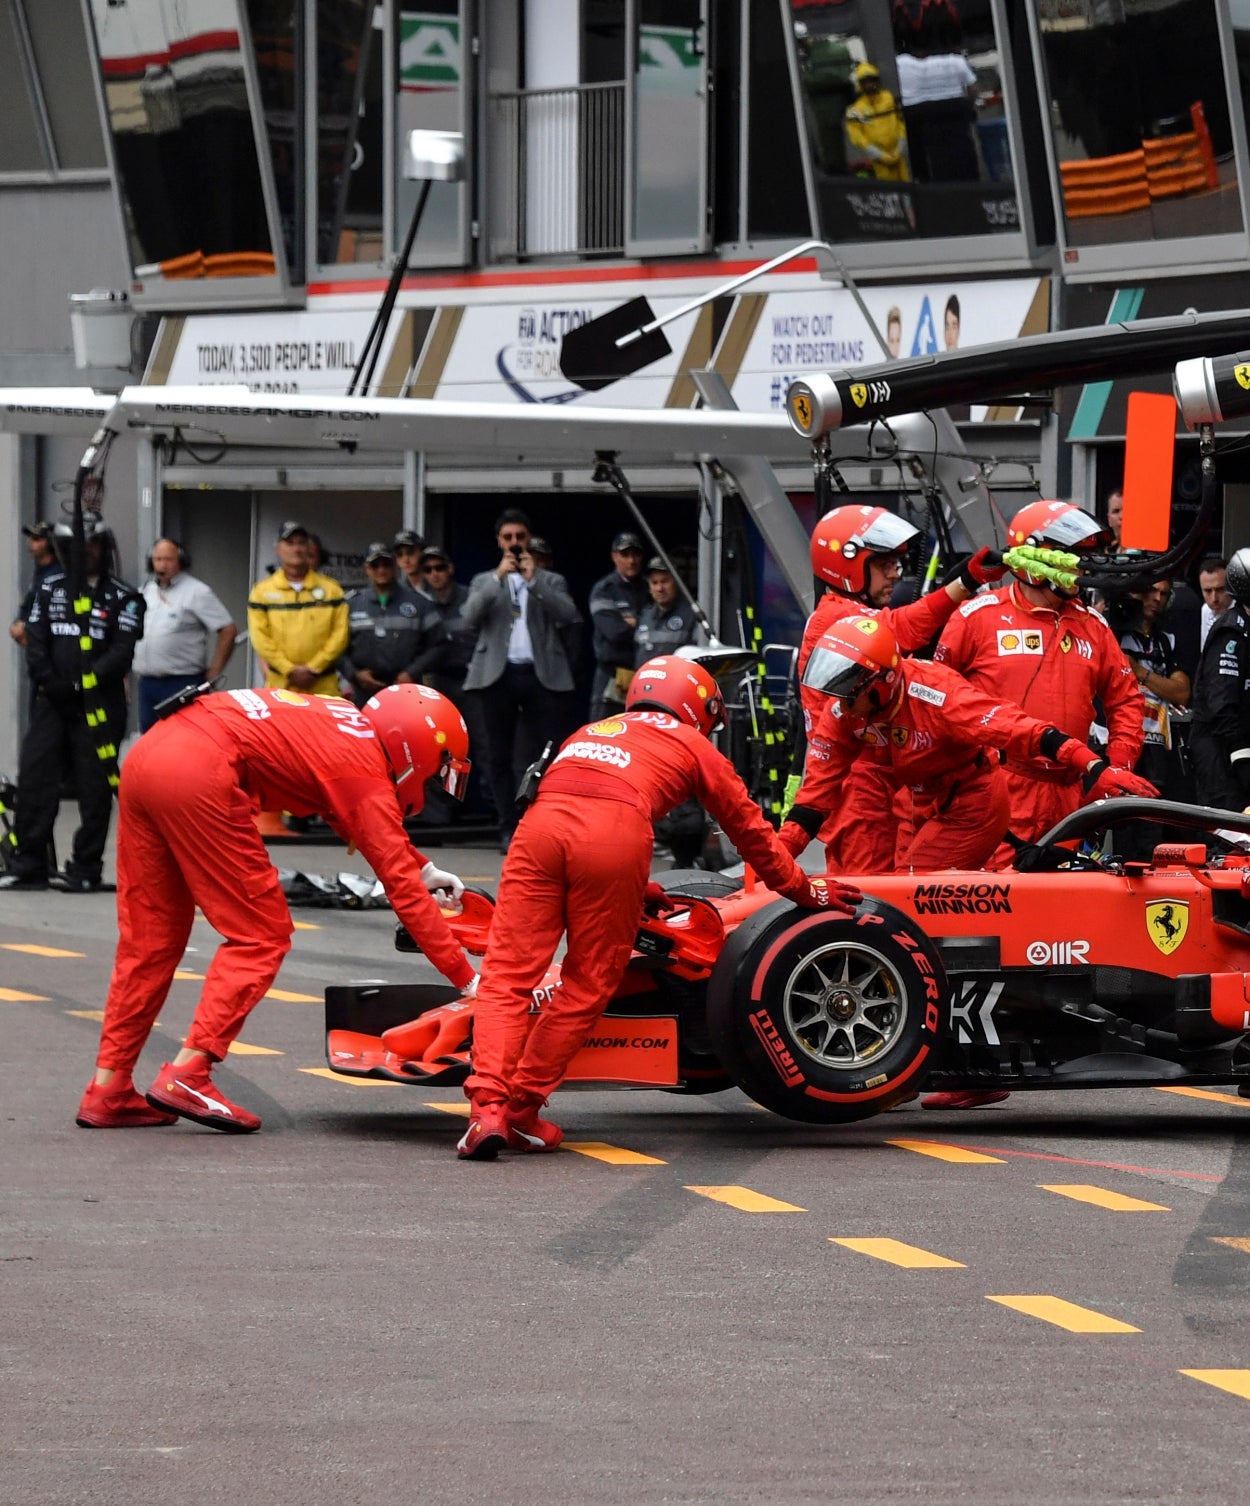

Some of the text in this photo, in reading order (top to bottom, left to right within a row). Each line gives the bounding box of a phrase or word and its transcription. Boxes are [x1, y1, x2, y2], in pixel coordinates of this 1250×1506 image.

[772, 314, 832, 337] WATCH OUT
[197, 345, 236, 375] TODAY,
[275, 343, 321, 370] PEOPLE
[325, 342, 358, 369] WILL
[772, 341, 863, 364] FOR PEDESTRIANS
[1025, 637, 1040, 649] ups
[914, 884, 1011, 899] MISSION
[914, 899, 1012, 914] WINNOW
[857, 913, 939, 1033] P ZERO
[748, 1008, 806, 1088] PIRELLI
